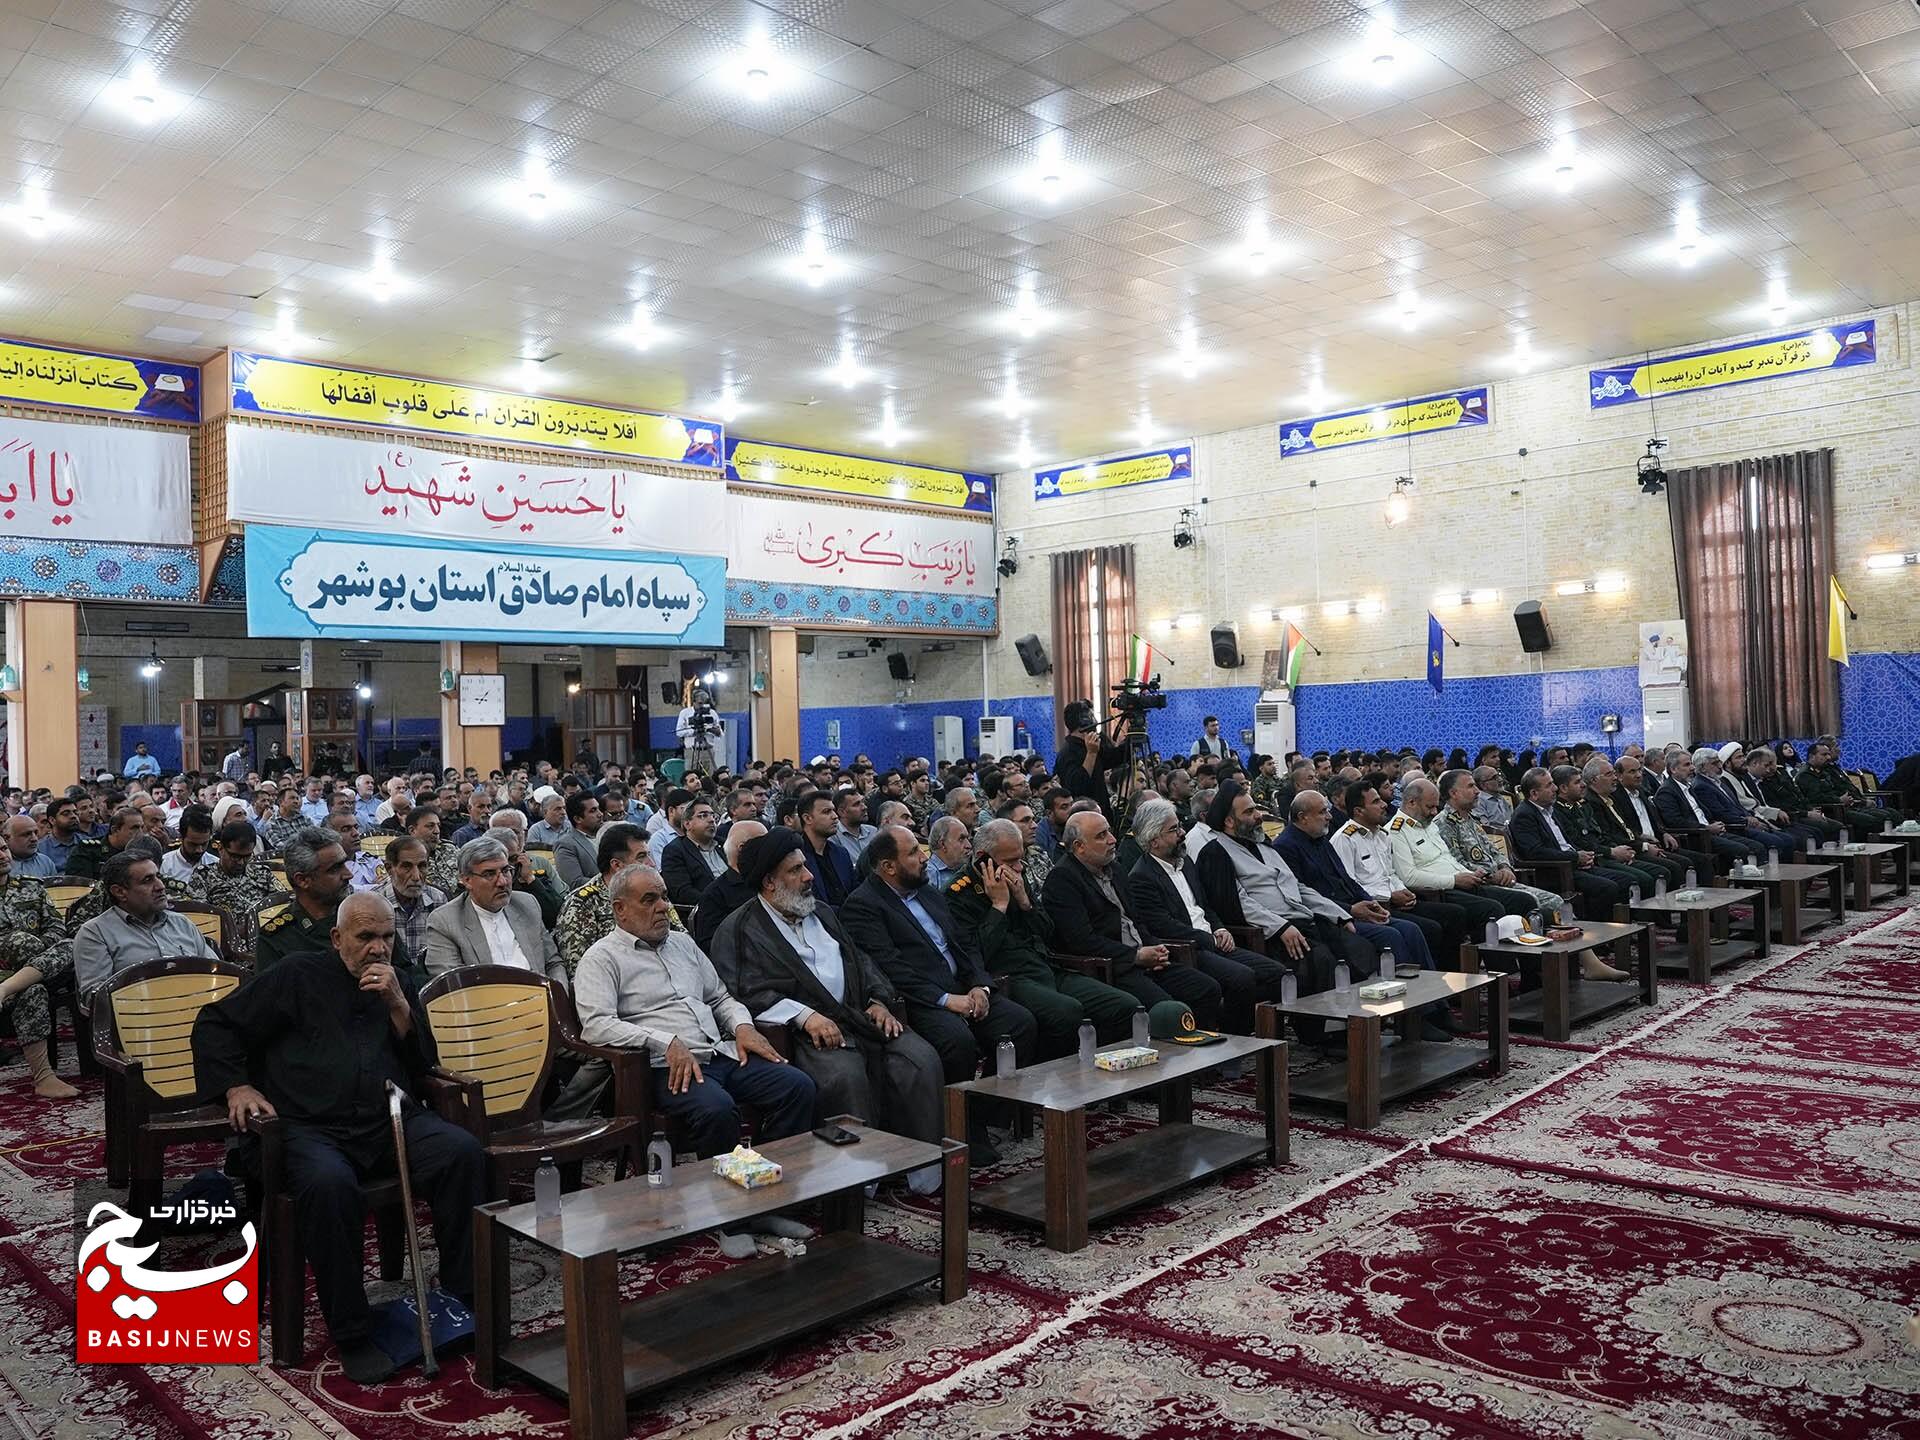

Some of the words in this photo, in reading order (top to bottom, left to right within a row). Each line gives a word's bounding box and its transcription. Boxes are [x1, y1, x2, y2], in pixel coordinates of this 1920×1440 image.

[1756, 355, 1774, 370] تدبر
[1775, 351, 1798, 366] قرآن
[1801, 351, 1811, 362] در
[1736, 359, 1754, 371] کنید
[1685, 371, 1693, 381] را
[1694, 366, 1706, 380] آن
[497, 560, 524, 574] السلام
[308, 560, 406, 612] بوشهر
[410, 564, 496, 613] استان
[499, 571, 578, 616] صادق
[581, 574, 633, 618] امام
[636, 576, 690, 622] سپاه
